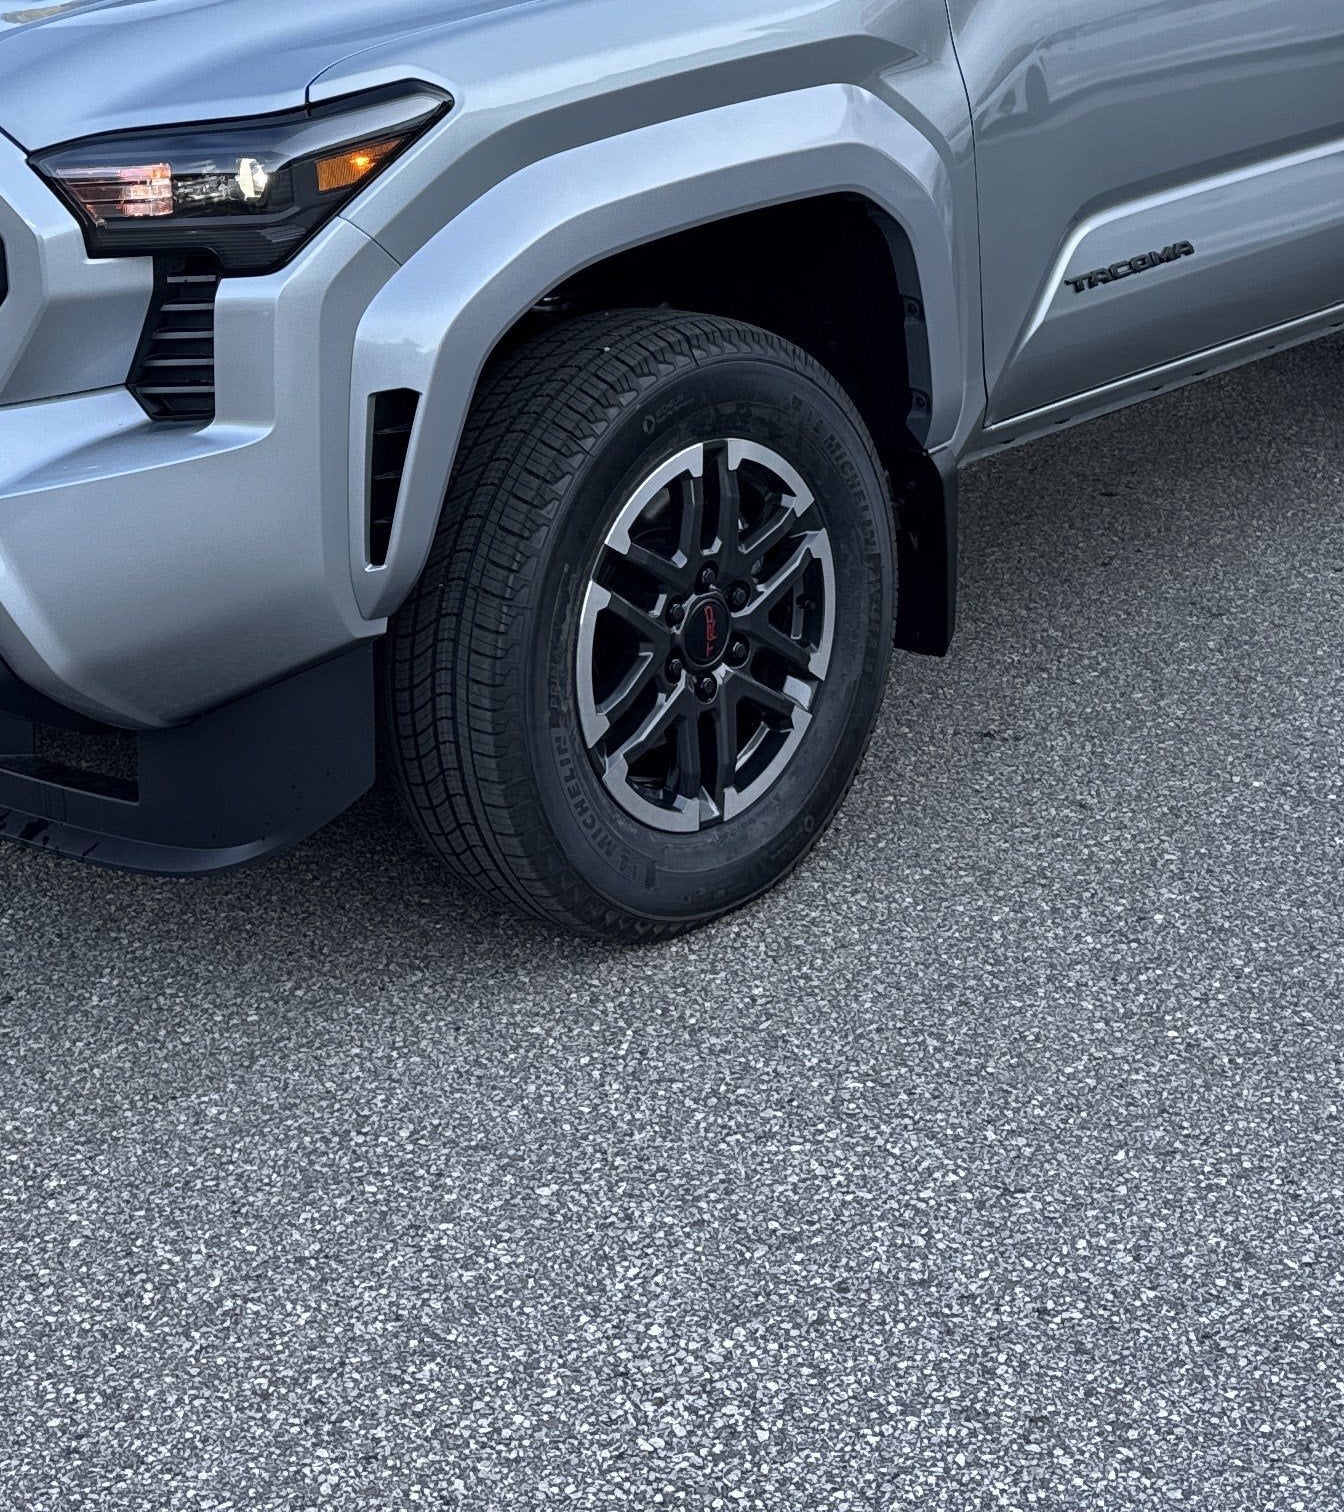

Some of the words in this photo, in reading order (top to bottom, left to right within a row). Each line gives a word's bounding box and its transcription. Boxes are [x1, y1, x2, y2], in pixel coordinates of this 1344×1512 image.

[1063, 240, 1195, 294] TACOMA
[704, 605, 717, 657] TRD
[553, 728, 616, 856] MICHELIN
